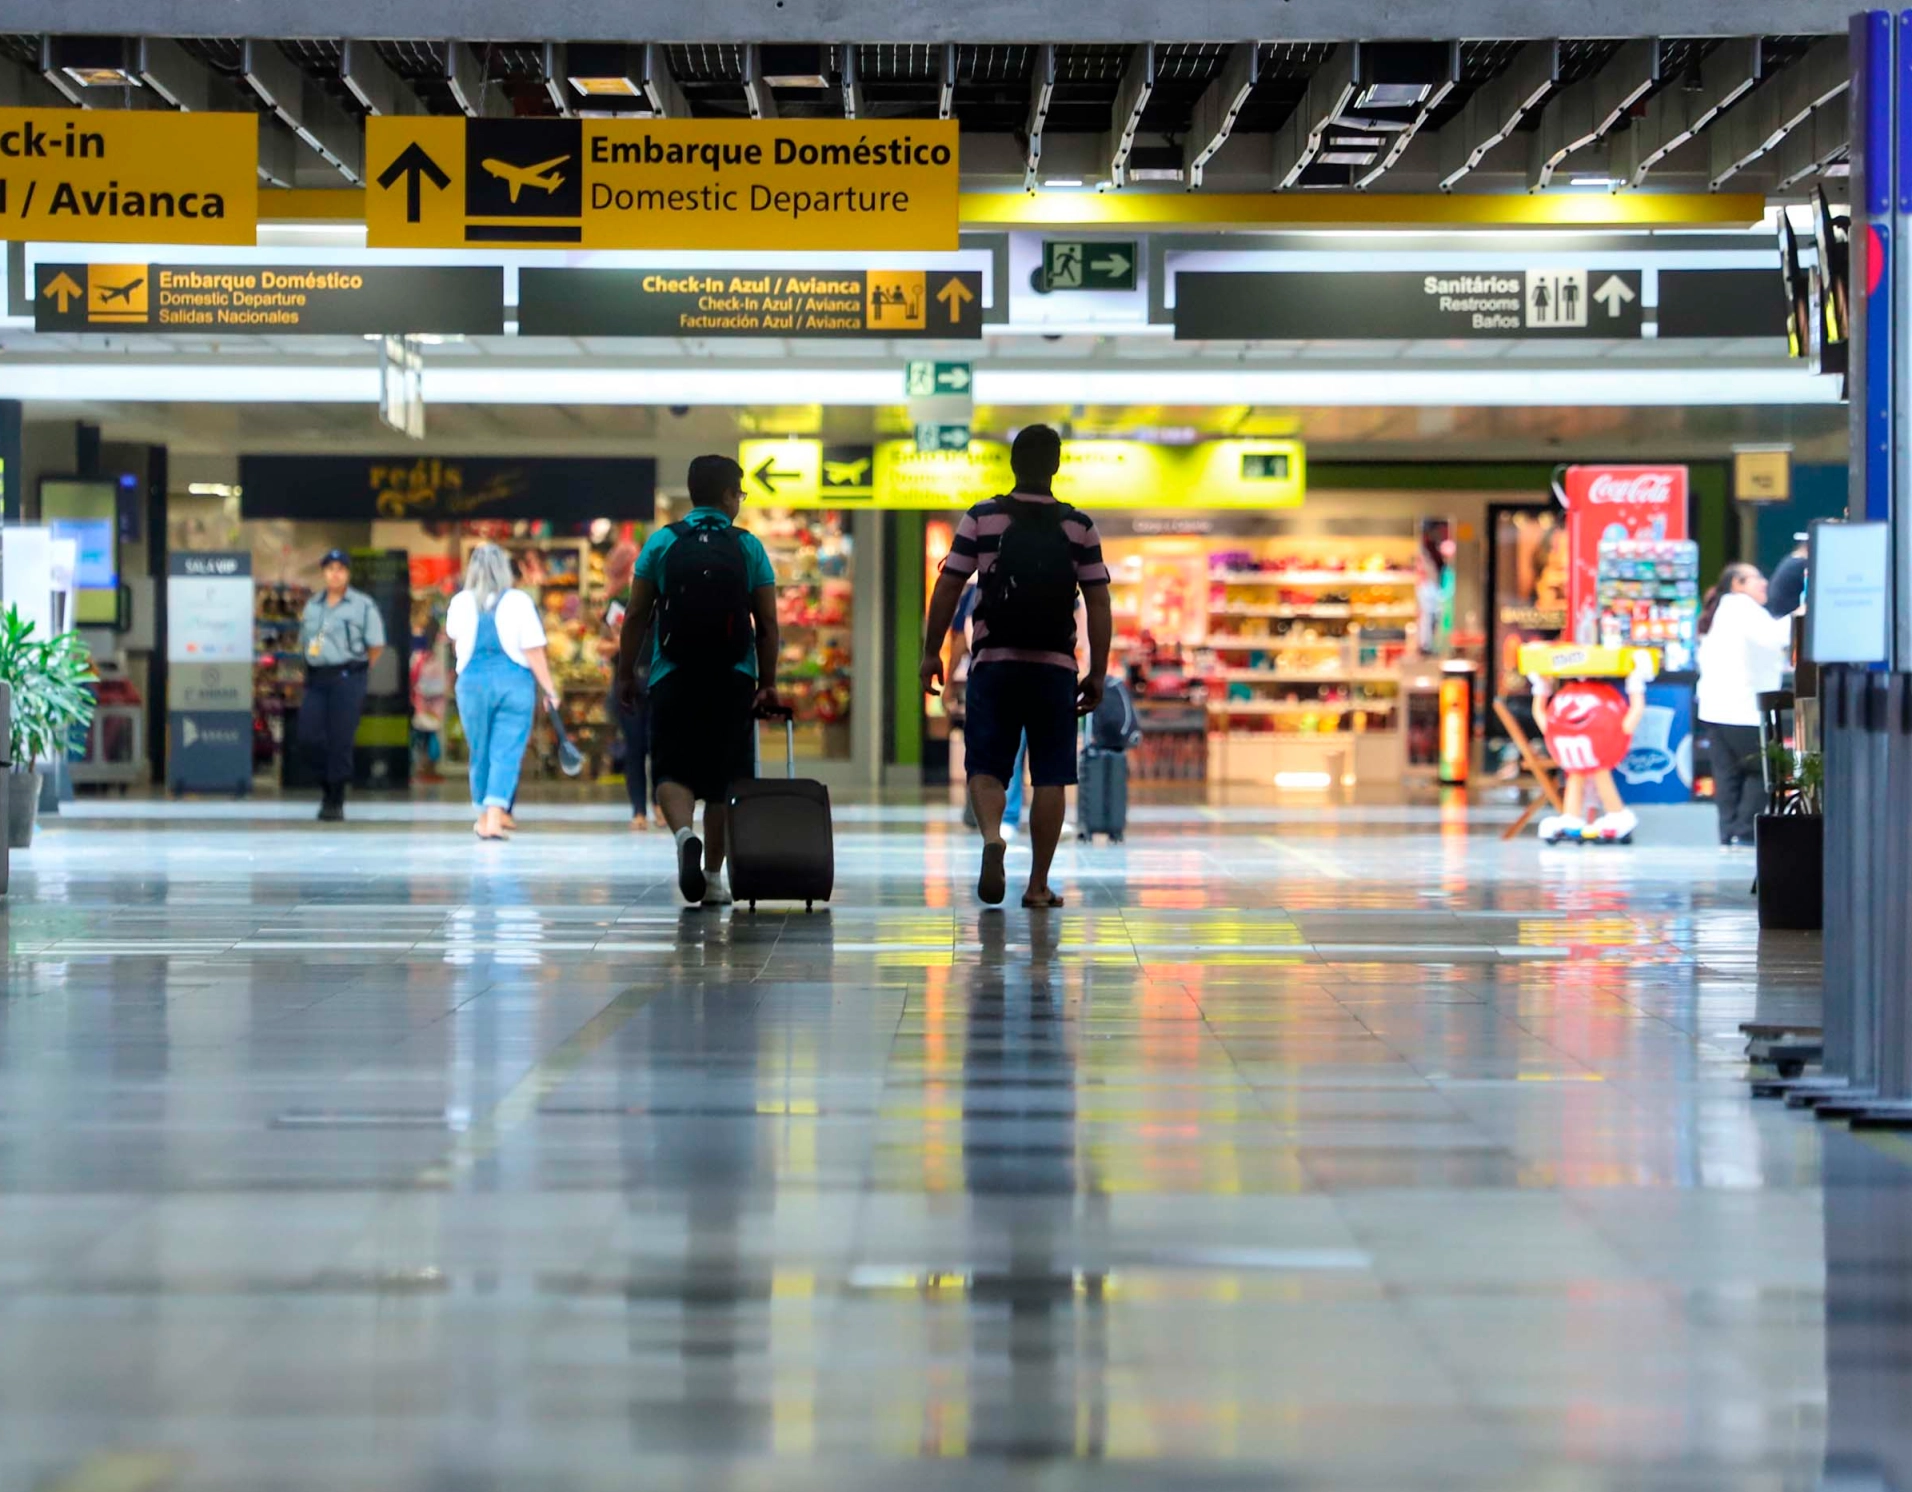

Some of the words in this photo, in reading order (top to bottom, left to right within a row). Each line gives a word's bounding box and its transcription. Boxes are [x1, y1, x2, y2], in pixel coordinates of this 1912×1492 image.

[590, 135, 762, 171] Embarque
[774, 136, 951, 165] Doméstico
[48, 181, 225, 219] Avianca
[591, 182, 738, 212] Domestic
[750, 184, 910, 219] Departure
[159, 271, 256, 291] Embarque
[261, 271, 363, 290] Doméstico
[729, 277, 770, 294] Azul
[773, 277, 783, 295] /
[786, 277, 861, 295] Avianca
[1424, 276, 1520, 293] Sanitários
[159, 291, 229, 306] Domestic
[233, 292, 306, 308] Departure
[762, 297, 792, 312] Azul
[795, 297, 802, 312] /
[805, 297, 861, 312] Avianca
[1440, 297, 1520, 312] Restrooms
[159, 308, 213, 324] Salidas
[217, 309, 299, 324] Nacionales
[680, 313, 759, 328] Facturación
[762, 314, 793, 329] Azul
[796, 314, 803, 330] /
[806, 314, 861, 329] Avianca
[1472, 313, 1520, 329] Baños
